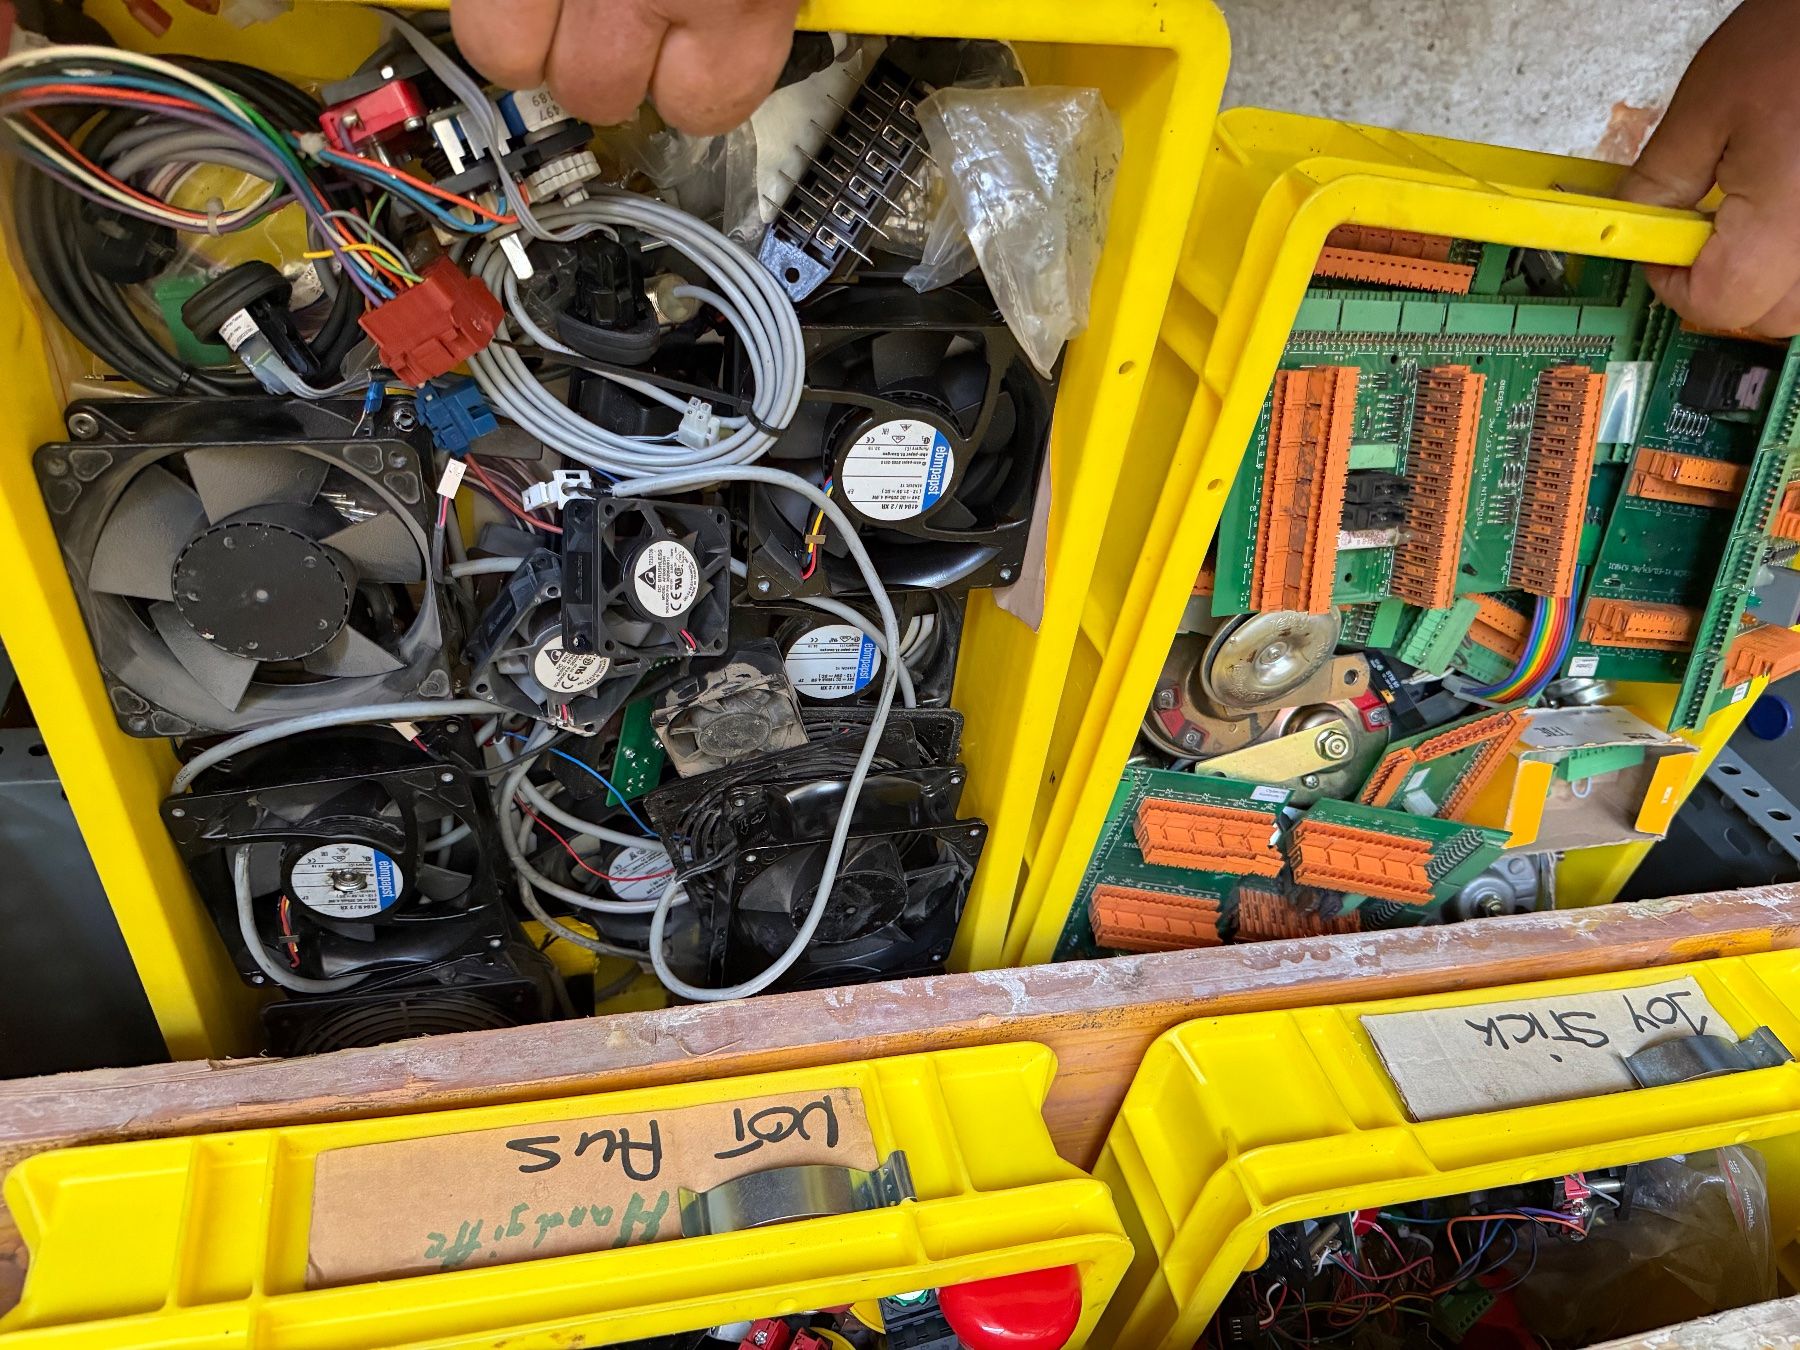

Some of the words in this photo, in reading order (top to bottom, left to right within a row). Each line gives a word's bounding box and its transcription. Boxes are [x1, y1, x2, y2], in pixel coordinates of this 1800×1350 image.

[928, 446, 948, 495] ebmpapst
[859, 643, 875, 679] ebmpapst
[378, 860, 396, 897] ebmpapst
